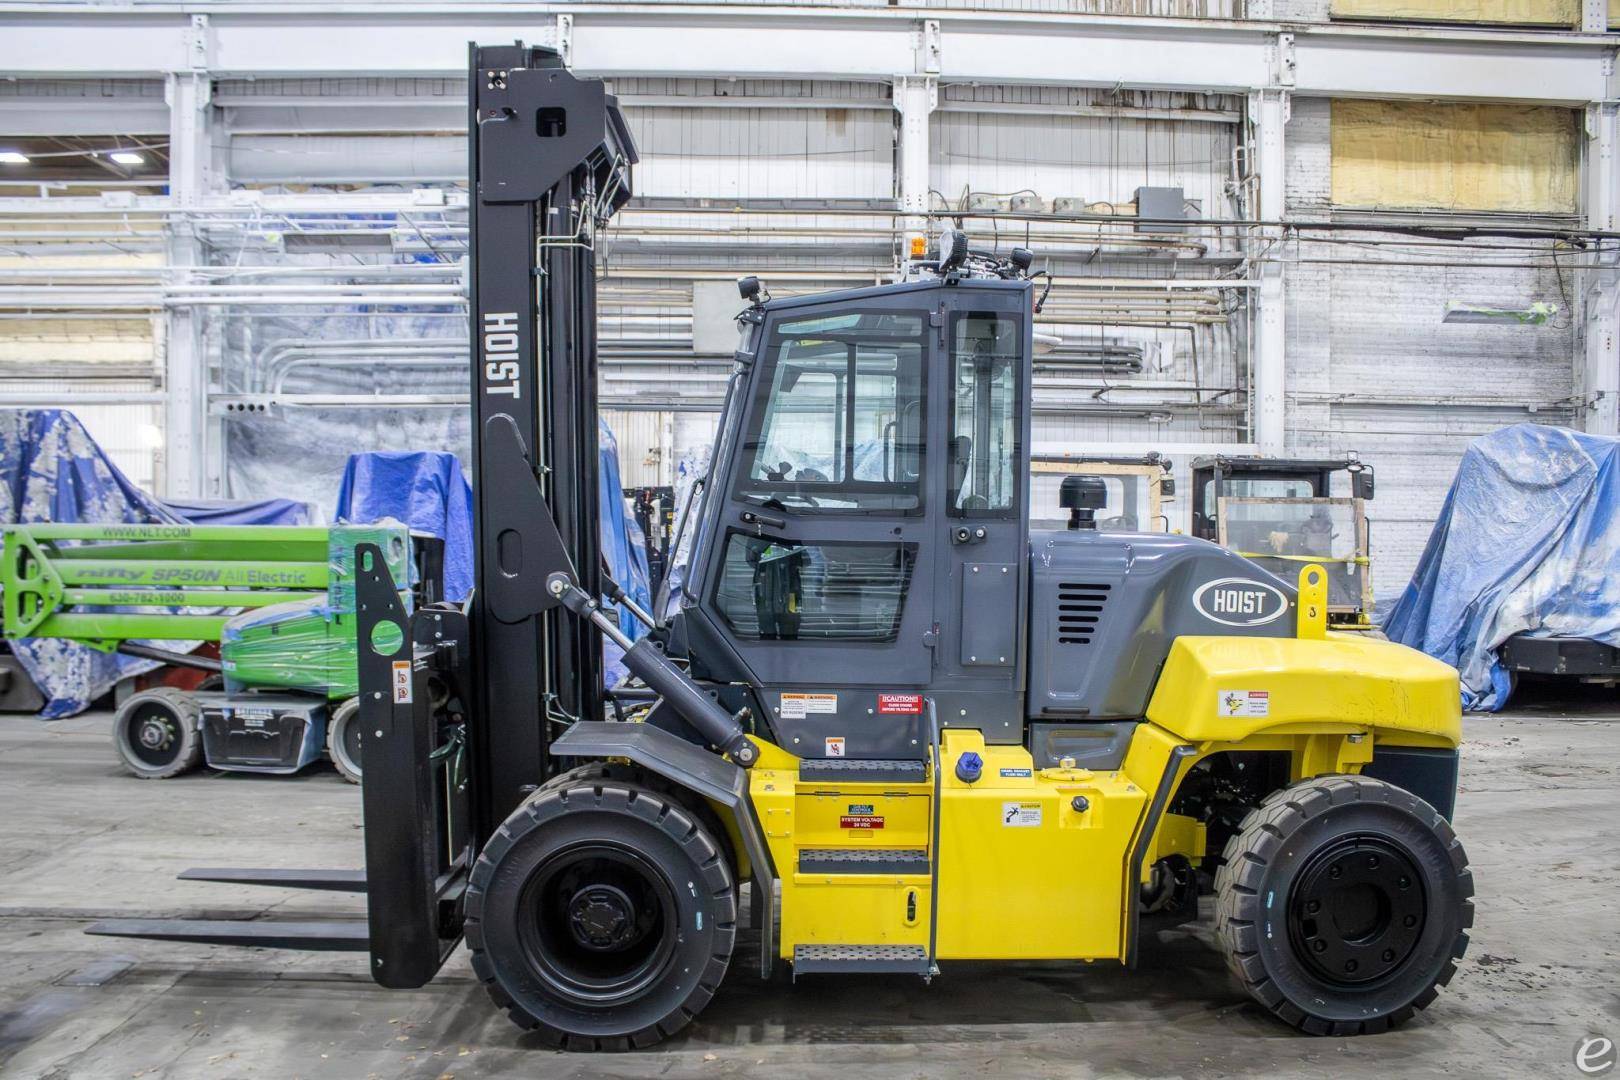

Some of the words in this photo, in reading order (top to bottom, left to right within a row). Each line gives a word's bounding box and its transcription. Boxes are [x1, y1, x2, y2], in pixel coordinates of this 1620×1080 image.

[484, 312, 520, 399] HOIST
[151, 568, 221, 582] SP50N
[247, 570, 306, 584] Electric
[1214, 589, 1267, 614] HOIST
